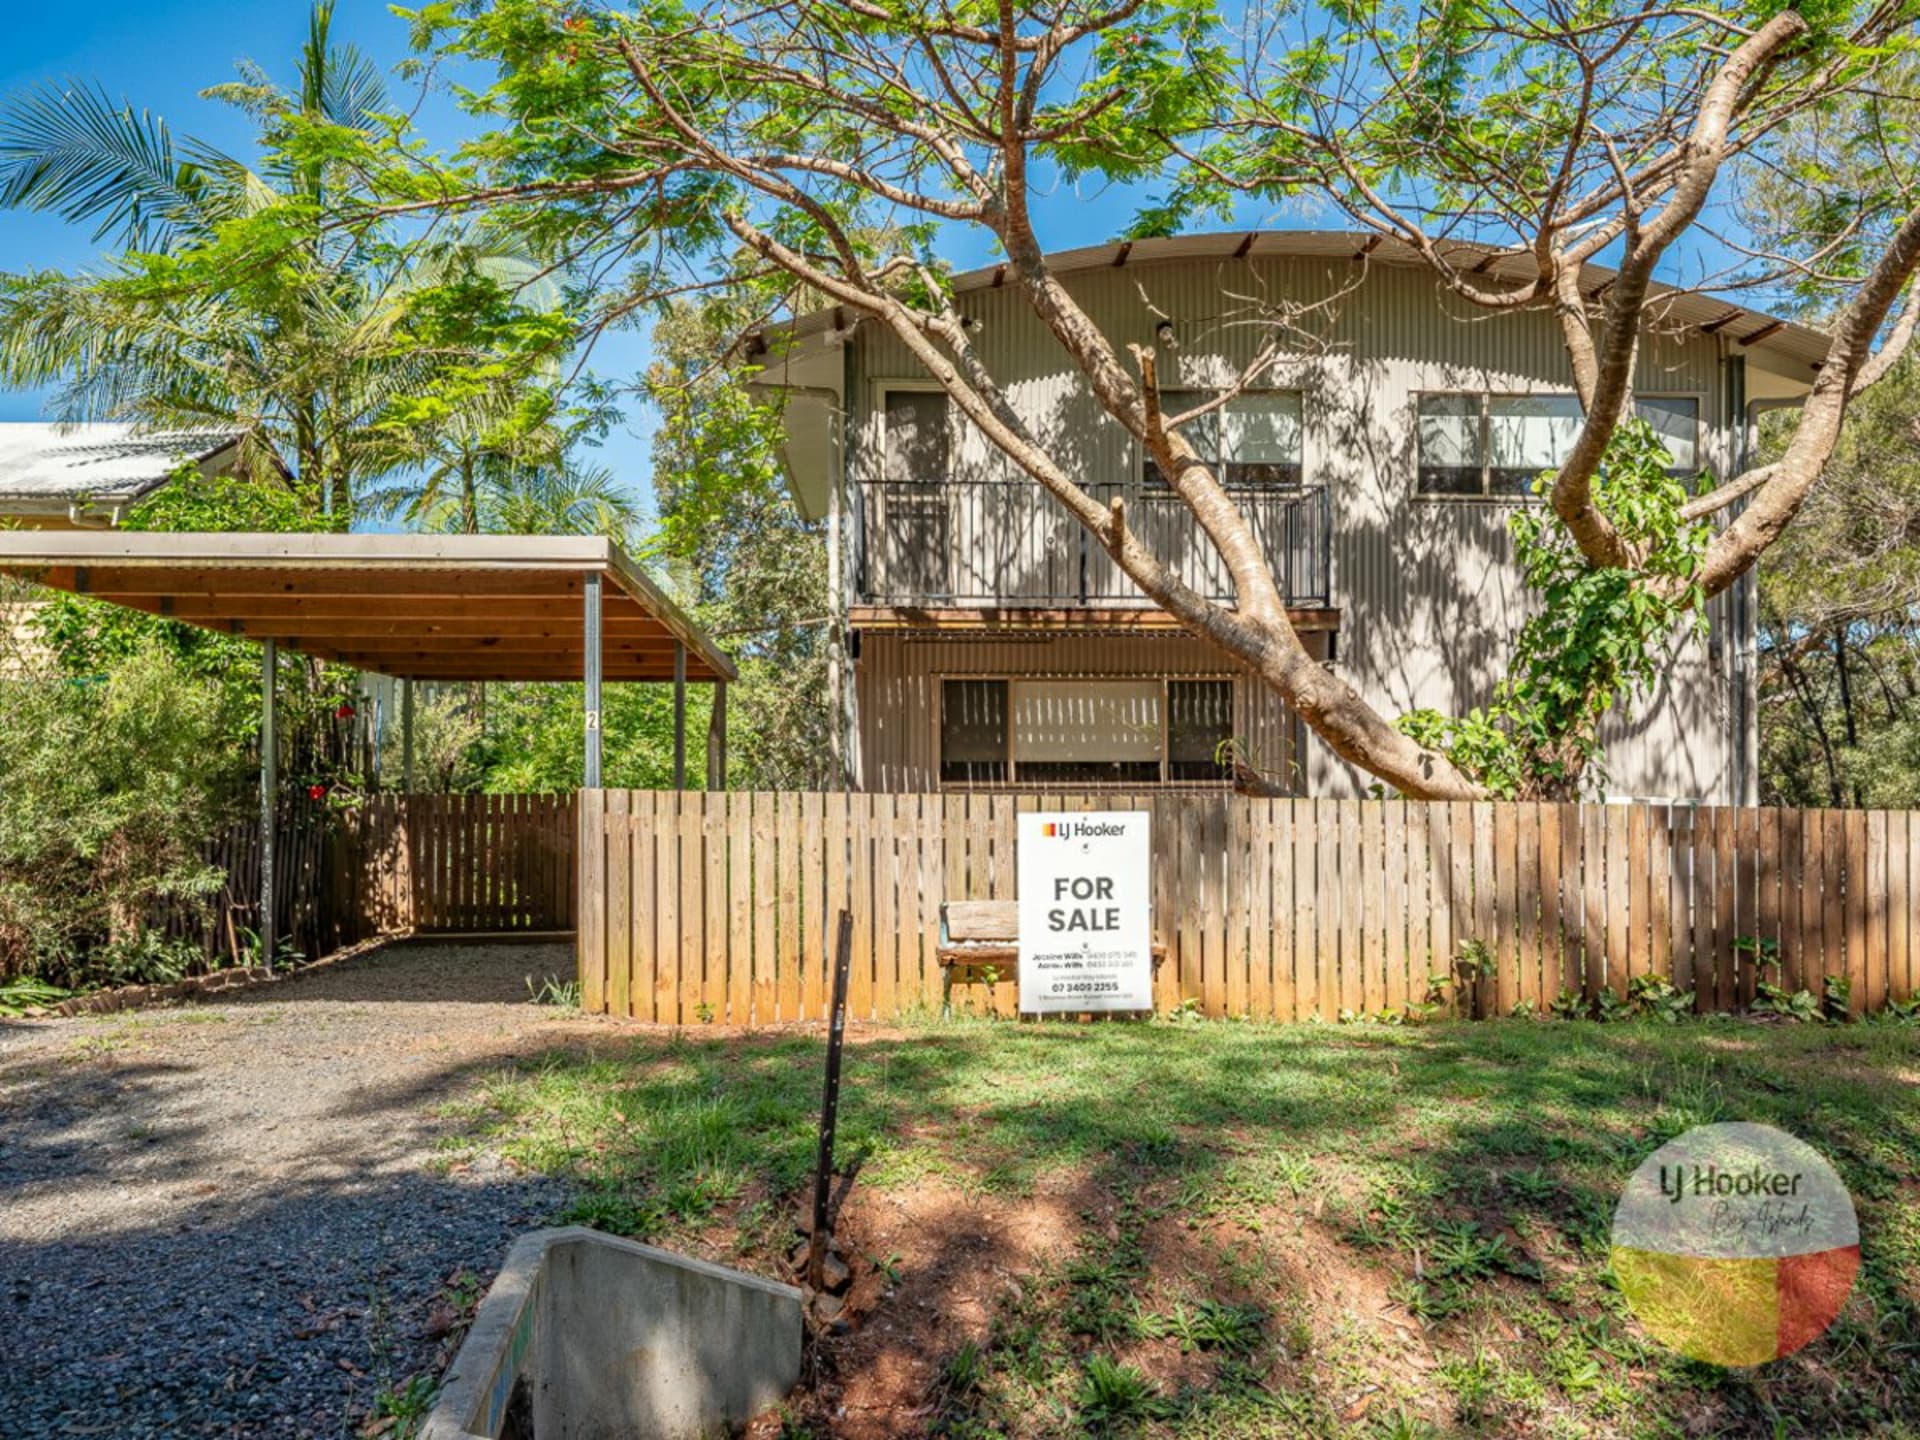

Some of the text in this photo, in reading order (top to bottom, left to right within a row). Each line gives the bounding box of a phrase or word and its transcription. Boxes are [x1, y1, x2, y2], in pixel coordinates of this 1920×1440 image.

[588, 712, 596, 728] 2
[1059, 822, 1125, 840] LJ Hooker
[1054, 877, 1114, 901] FOR
[1048, 908, 1120, 932] SALE
[1052, 983, 1064, 993] 07
